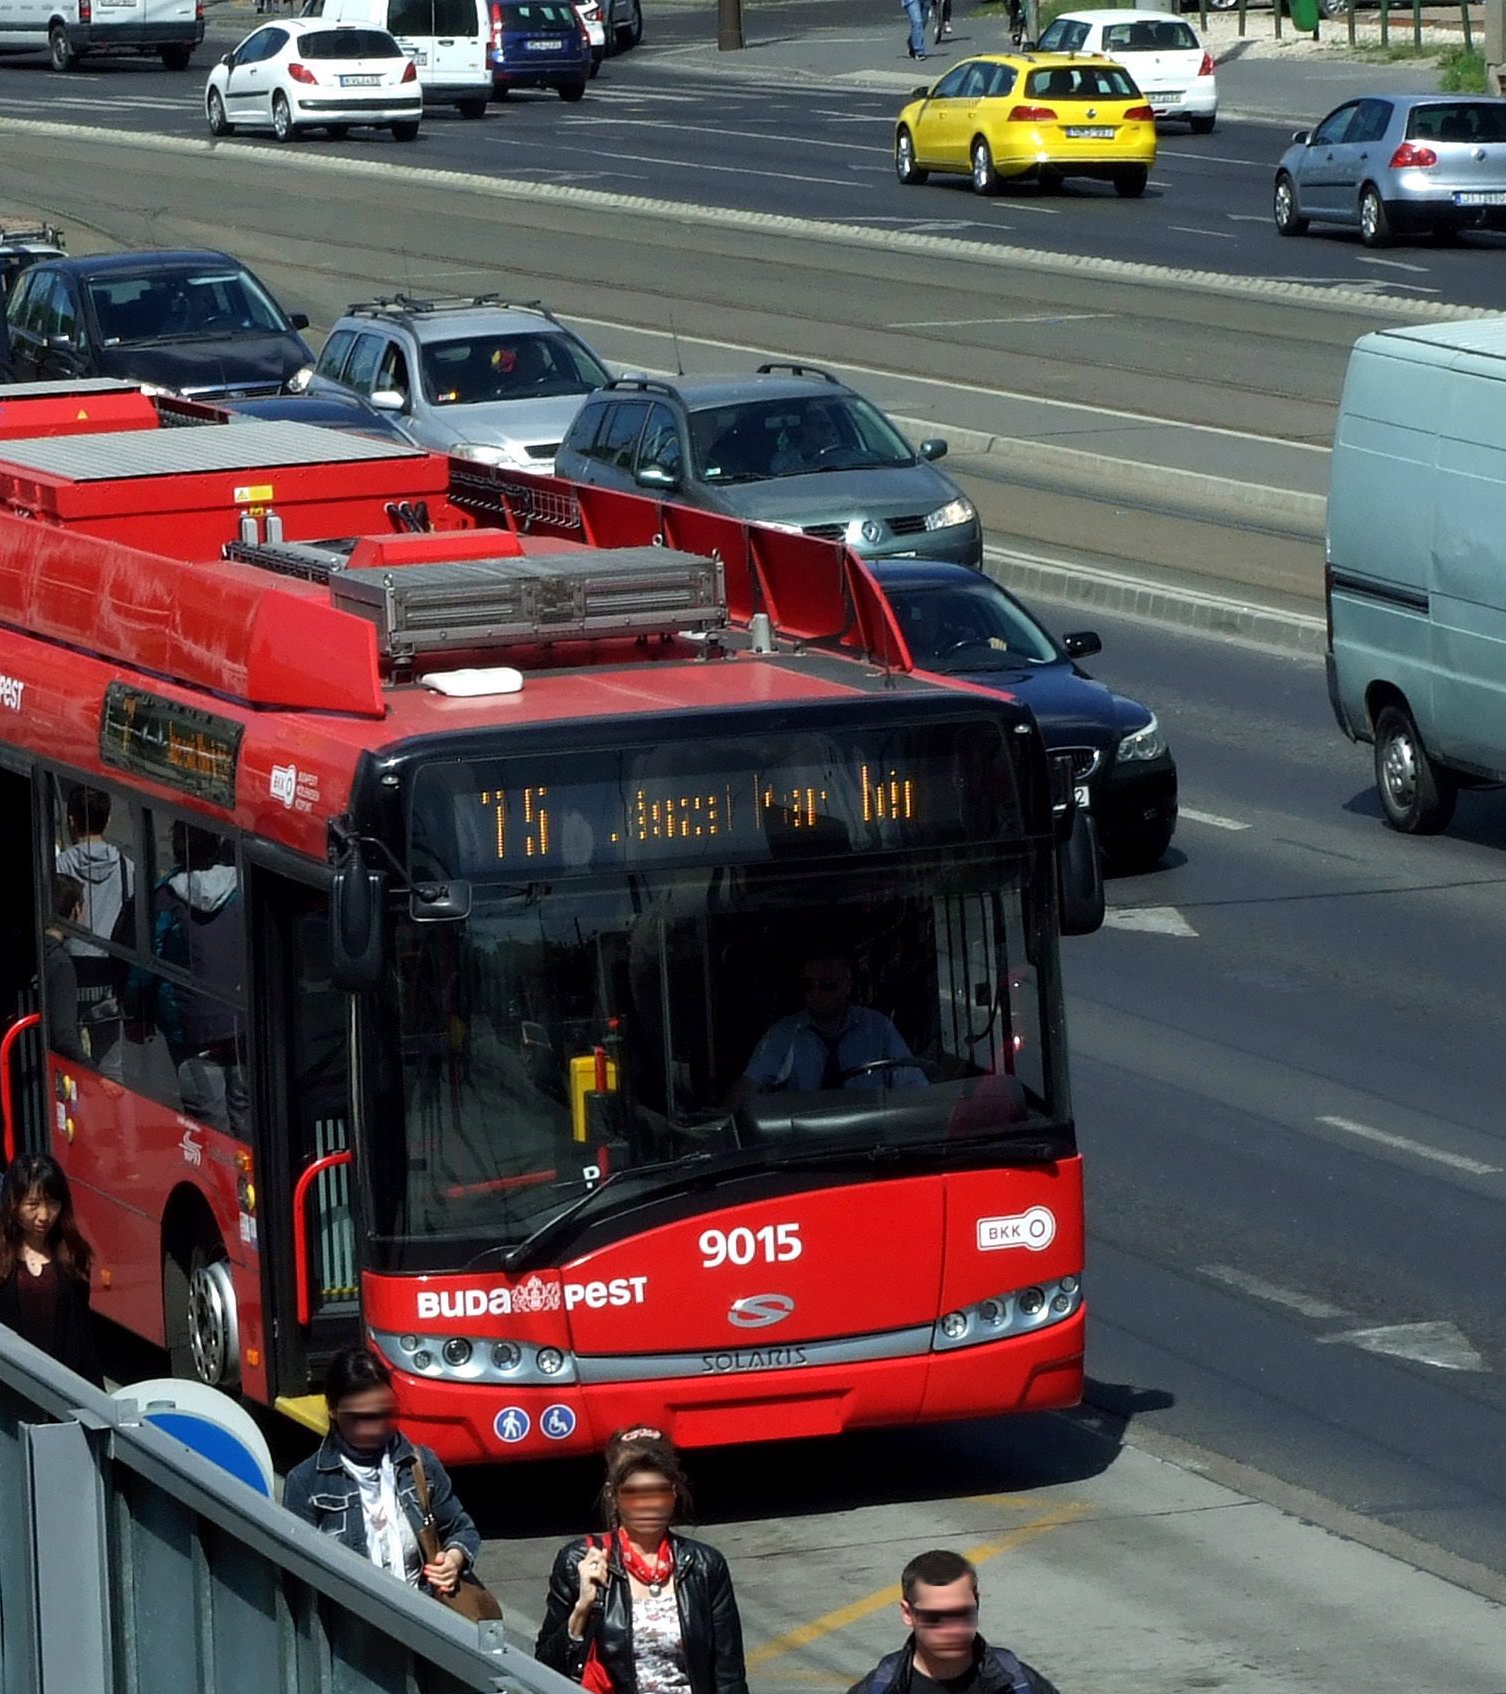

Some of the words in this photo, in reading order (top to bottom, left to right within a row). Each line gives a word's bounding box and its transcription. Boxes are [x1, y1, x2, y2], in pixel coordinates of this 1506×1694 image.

[698, 1222, 803, 1268] 9015
[988, 1224, 1021, 1240] BKK
[701, 1346, 807, 1374] SOLARIS
